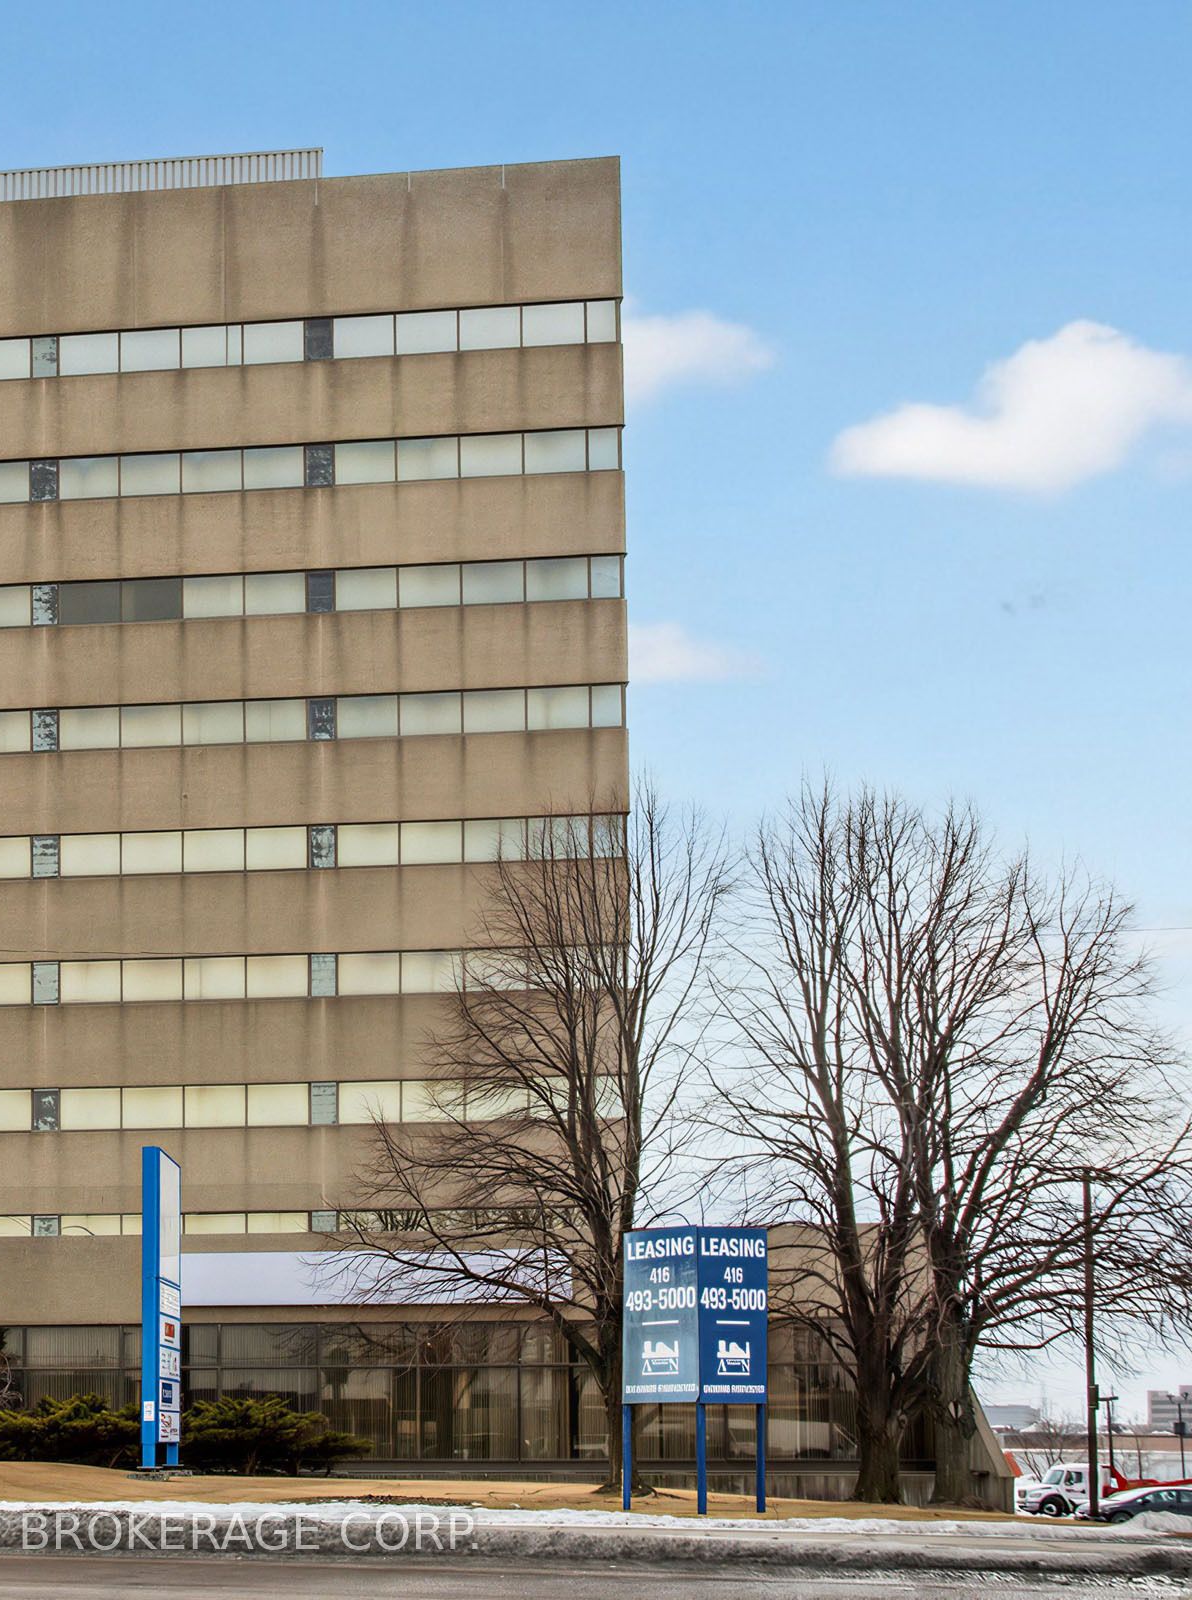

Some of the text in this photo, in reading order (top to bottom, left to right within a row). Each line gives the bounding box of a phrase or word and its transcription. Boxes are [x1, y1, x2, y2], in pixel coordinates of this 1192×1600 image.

[628, 1236, 694, 1260] LEASING
[701, 1237, 765, 1257] LEASING
[649, 1267, 669, 1283] 416
[724, 1267, 743, 1283] 416
[626, 1287, 696, 1311] 493-5000
[701, 1287, 766, 1310] 493-5000
